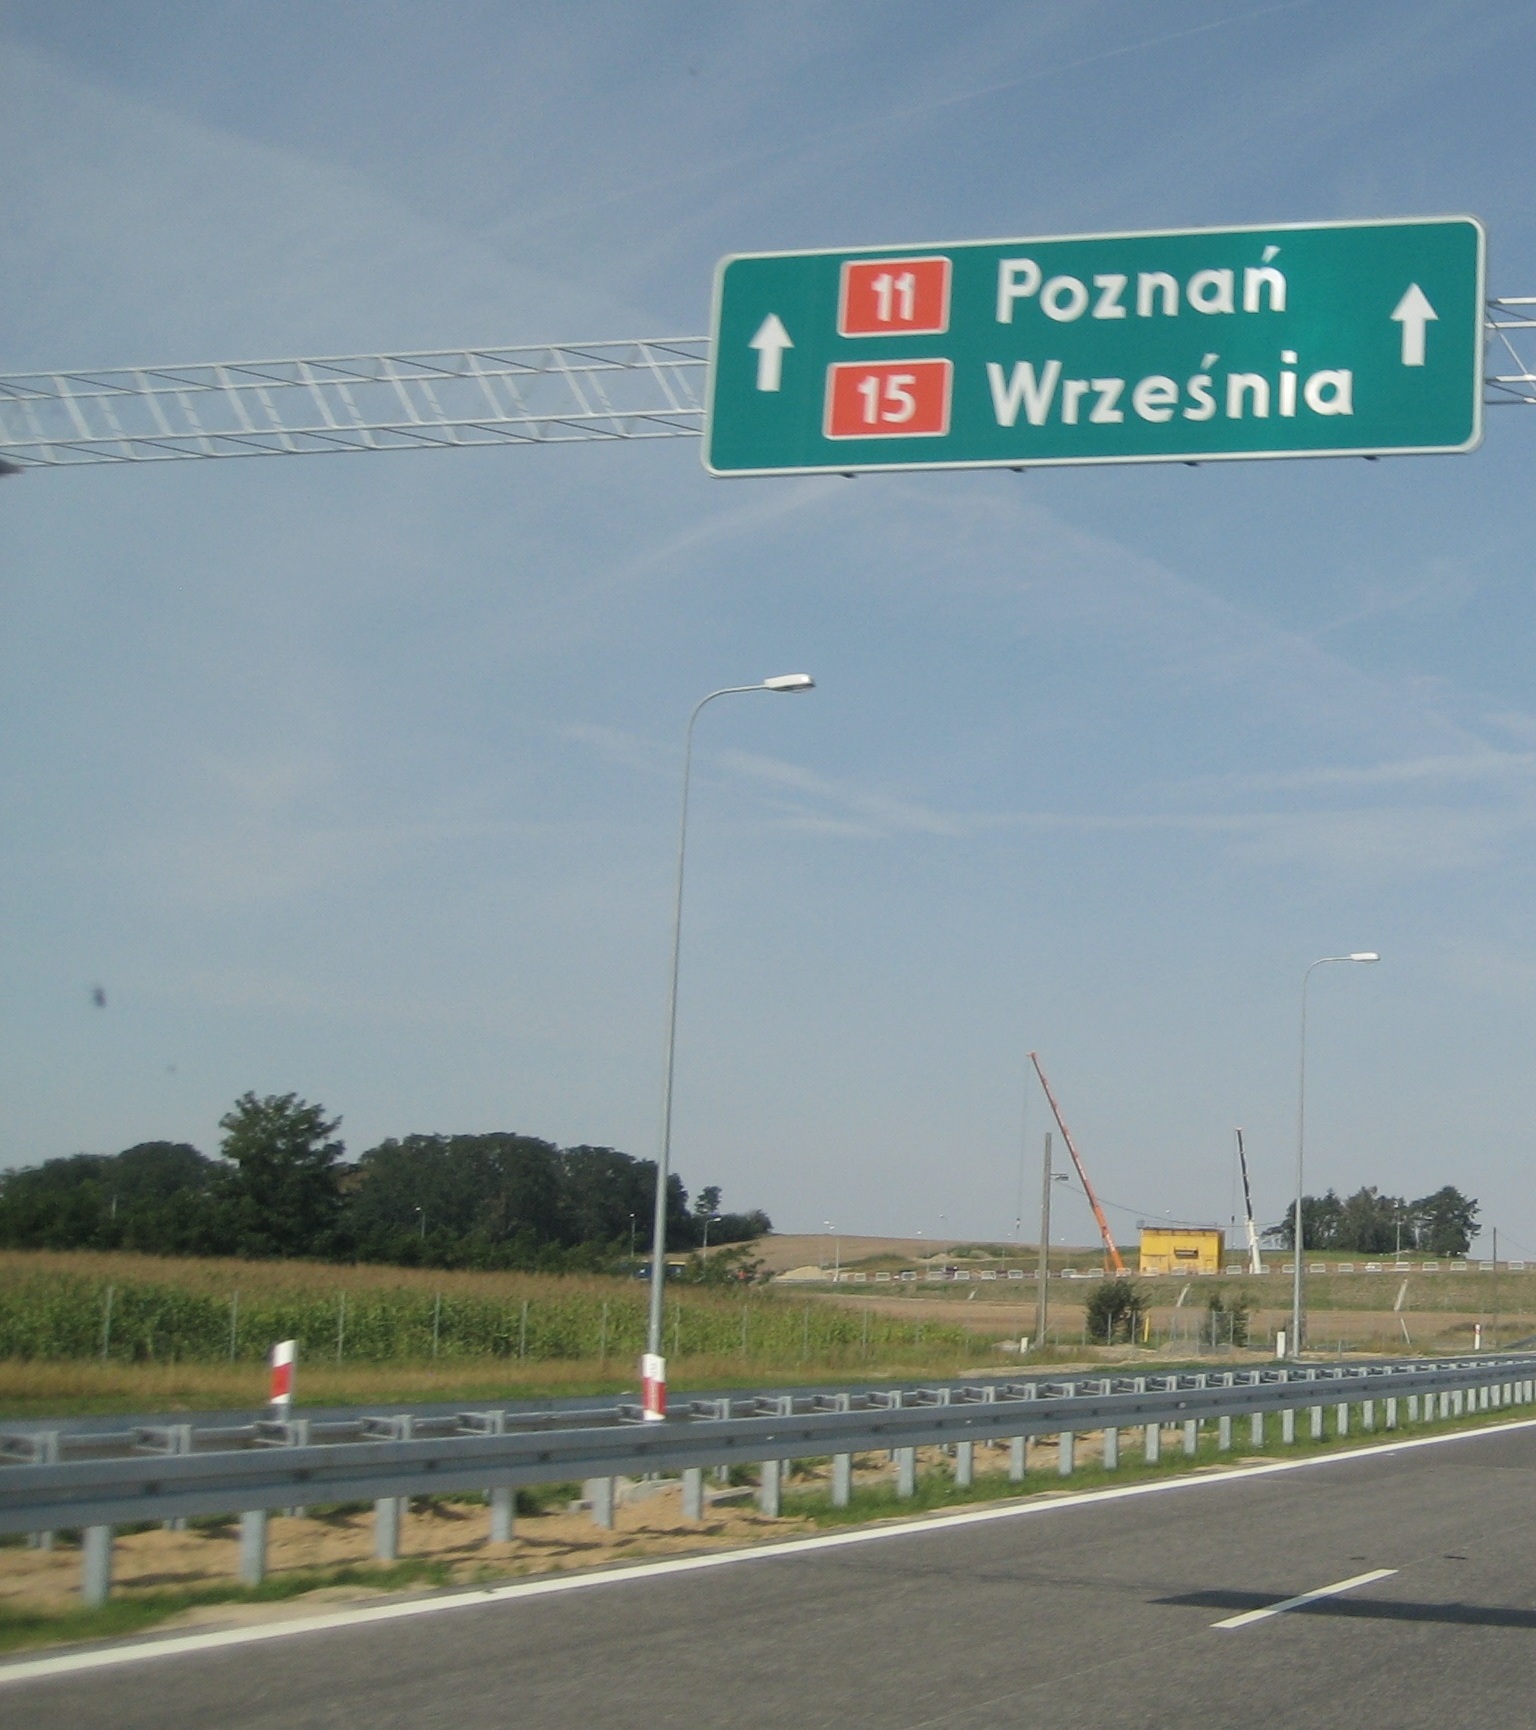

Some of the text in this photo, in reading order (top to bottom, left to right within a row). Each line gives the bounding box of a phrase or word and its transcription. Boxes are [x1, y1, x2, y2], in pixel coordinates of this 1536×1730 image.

[871, 272, 915, 322] 11
[996, 245, 1287, 324] Poznań
[858, 374, 915, 424] 15
[986, 349, 1353, 427] Września
